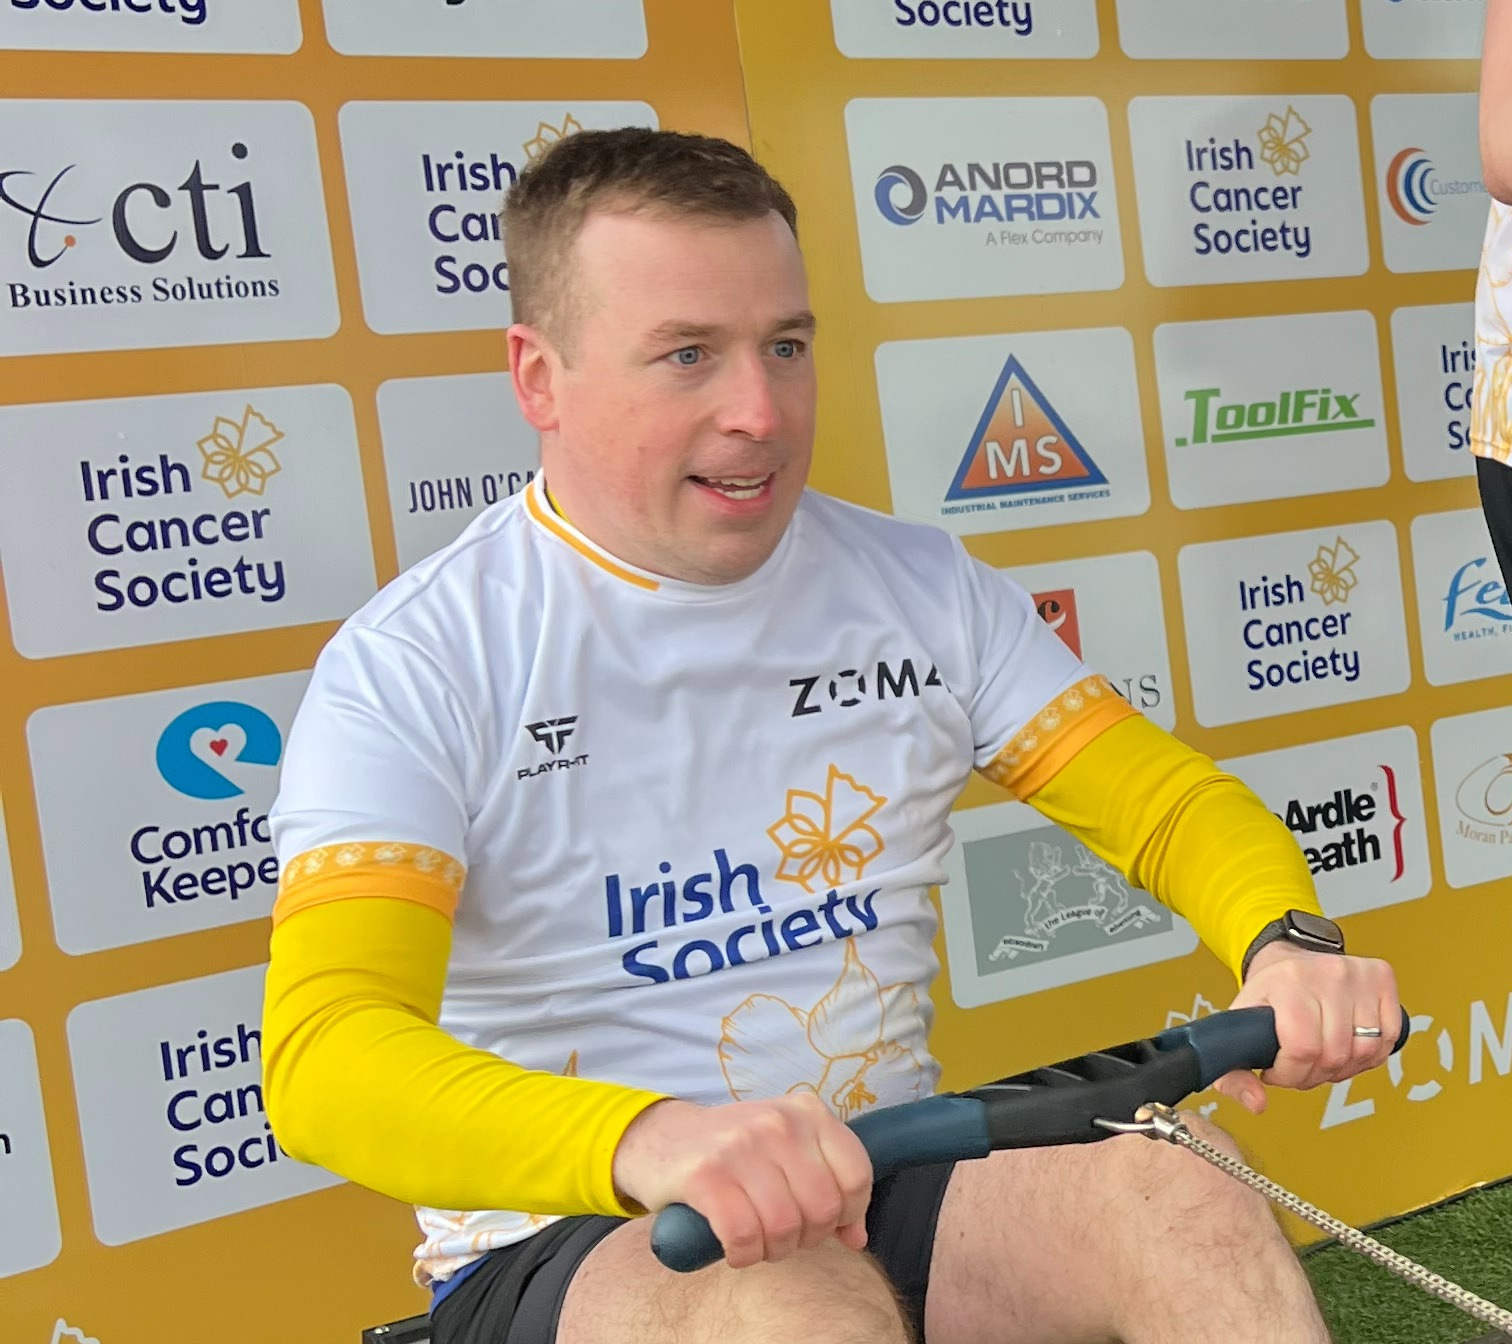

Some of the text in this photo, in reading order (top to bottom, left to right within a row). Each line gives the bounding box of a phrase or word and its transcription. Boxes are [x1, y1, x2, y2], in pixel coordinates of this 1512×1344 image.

[422, 151, 517, 192] Irish
[1185, 137, 1254, 172] Irish
[934, 160, 1097, 192] ANORD
[1189, 181, 1302, 212] Cancer
[112, 142, 271, 264] cti
[934, 192, 1100, 225] MARDIX
[986, 228, 1103, 246] A Flex Company
[1193, 221, 1311, 257] Society
[8, 275, 280, 308] Business Solutions
[1184, 387, 1361, 444] ToolFix
[80, 454, 192, 502] Irish
[409, 476, 473, 513] JOHN
[87, 507, 272, 557] Cancer
[94, 556, 286, 612] Society
[1240, 574, 1305, 612] Irish
[1243, 611, 1352, 650] Cancer
[1247, 647, 1360, 692] Society
[130, 807, 273, 865] Comfo
[1304, 828, 1381, 875] eath
[1456, 820, 1496, 844] Moran
[142, 858, 280, 908] Keepe
[605, 849, 763, 938] Irish
[167, 1081, 264, 1131] Can
